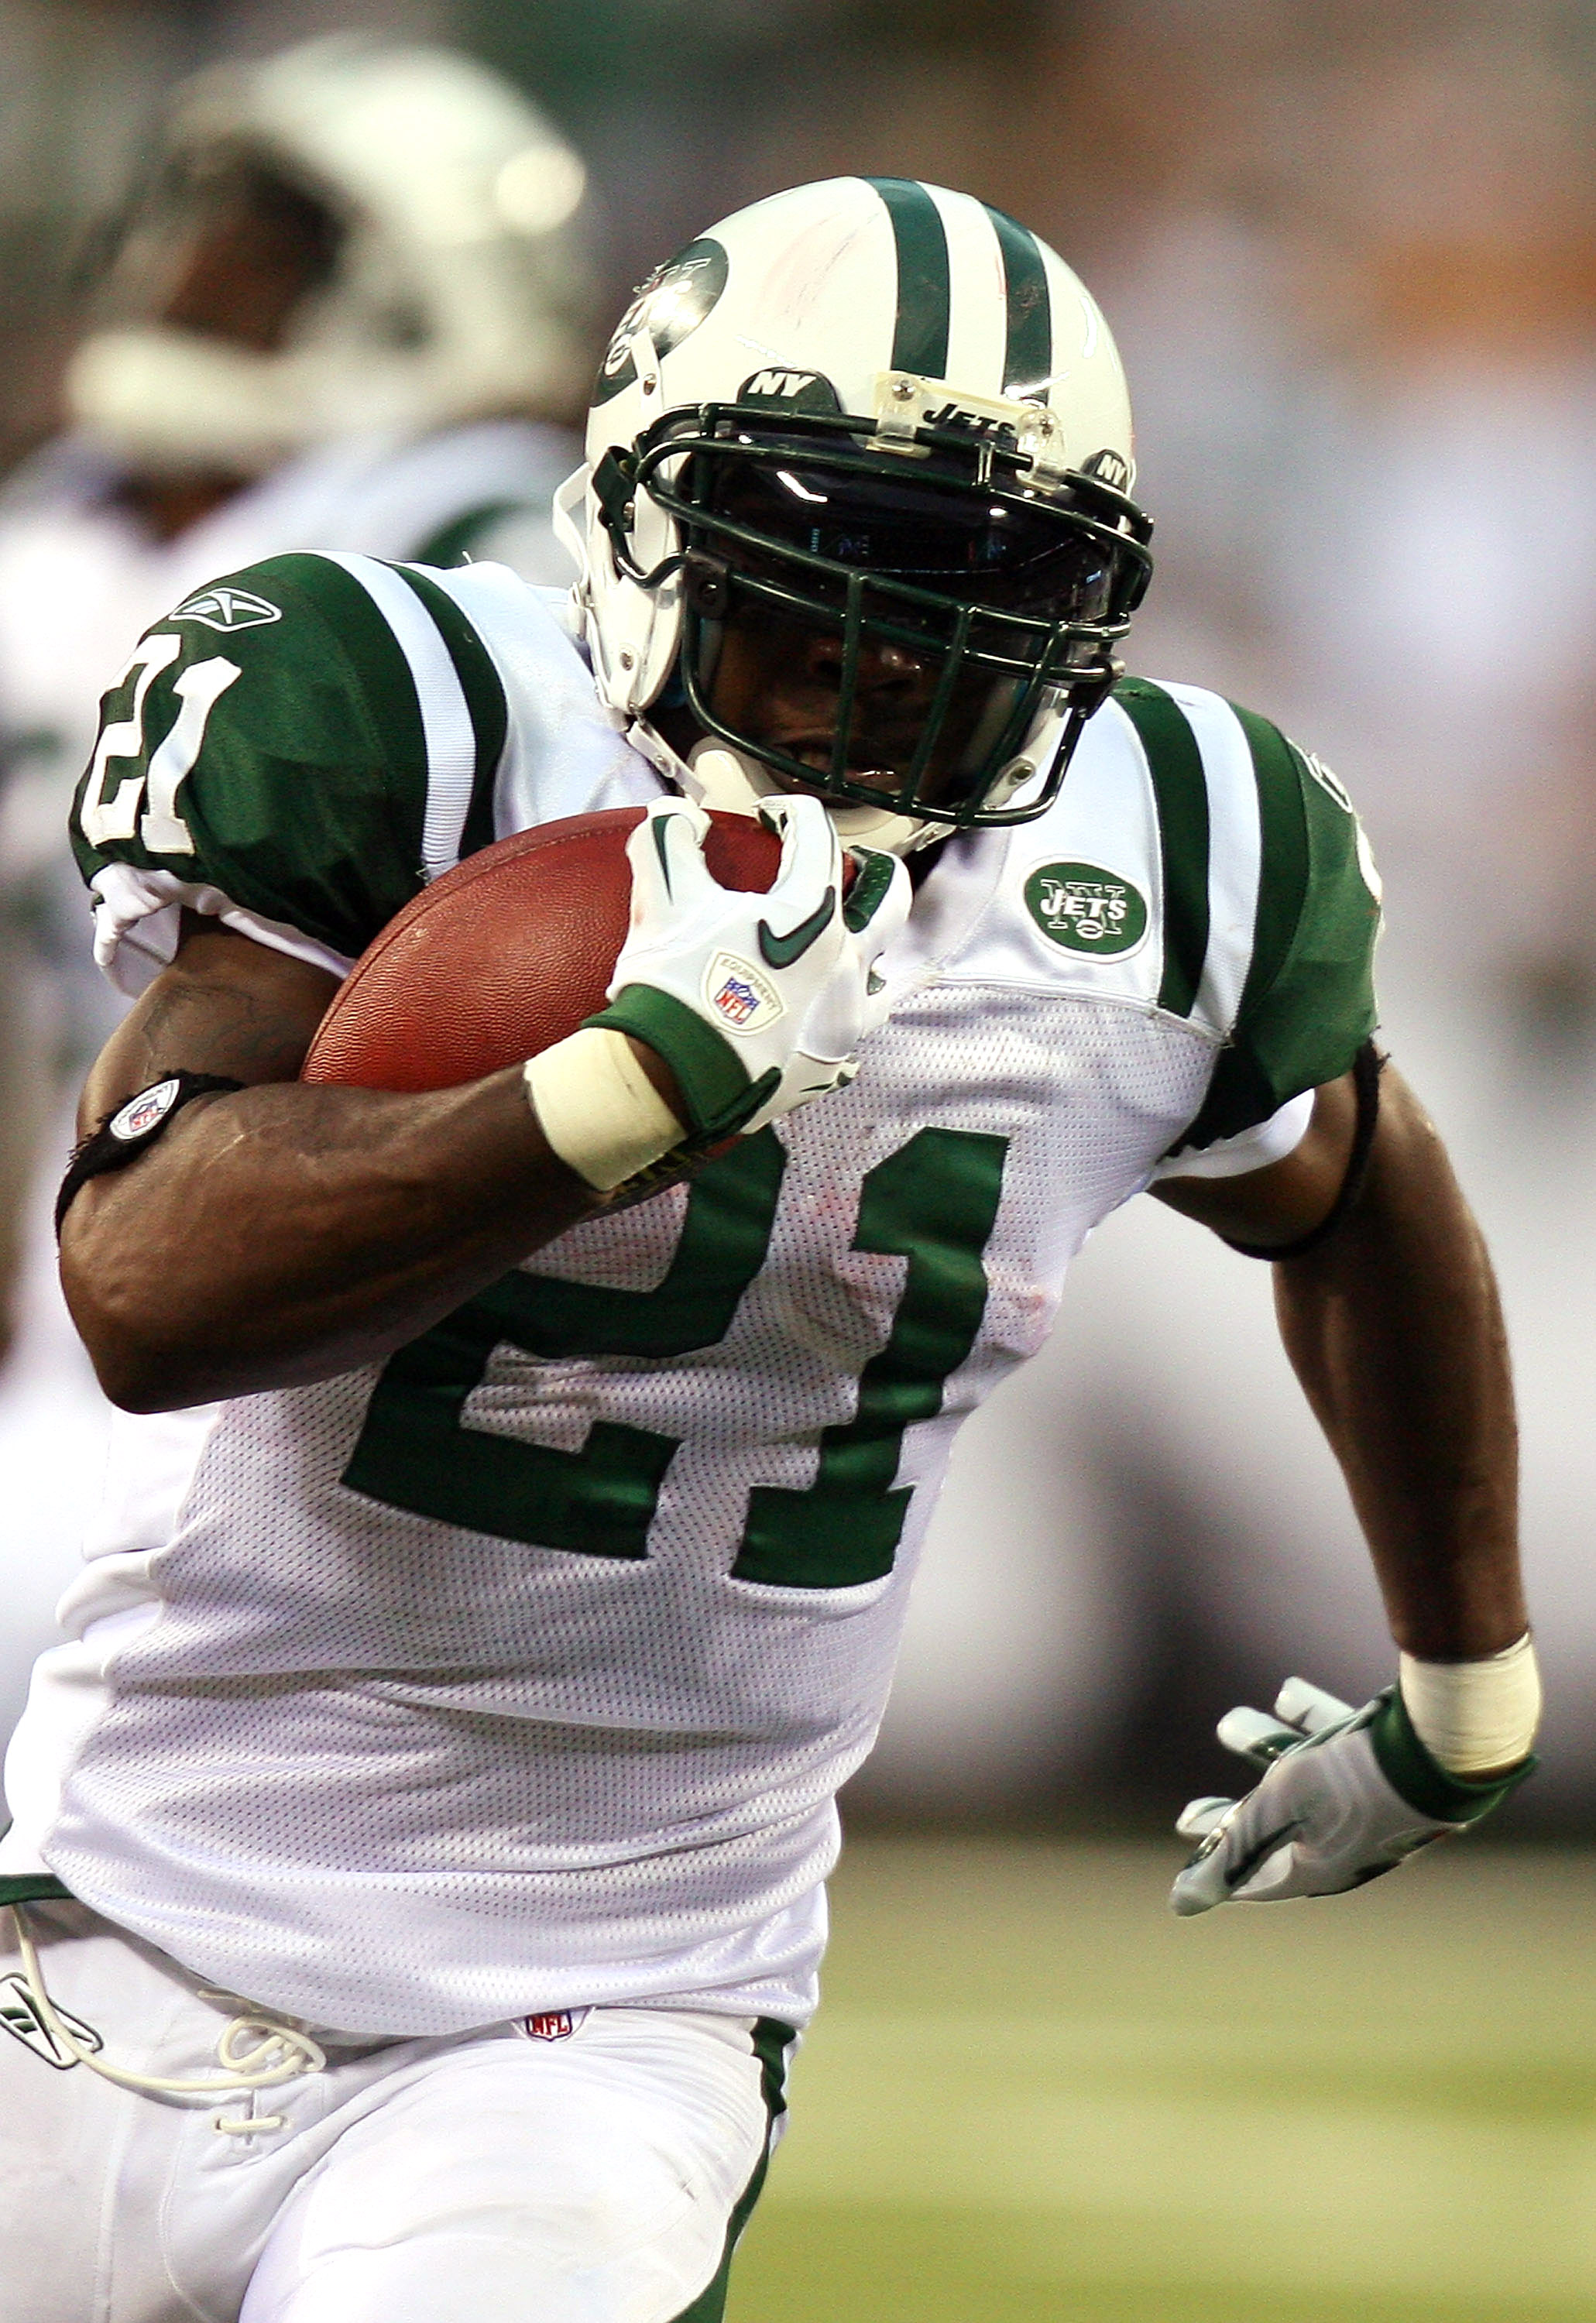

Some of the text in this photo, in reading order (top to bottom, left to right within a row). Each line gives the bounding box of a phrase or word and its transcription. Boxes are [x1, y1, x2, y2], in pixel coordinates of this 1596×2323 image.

[747, 371, 817, 397] NY
[922, 403, 1016, 435] JETS
[1097, 454, 1126, 486] NY
[81, 634, 242, 854] 21
[1040, 888, 1127, 921] JETS
[716, 989, 752, 1022] NFL
[340, 1127, 1010, 1589] 21
[529, 2015, 568, 2036] NFL
